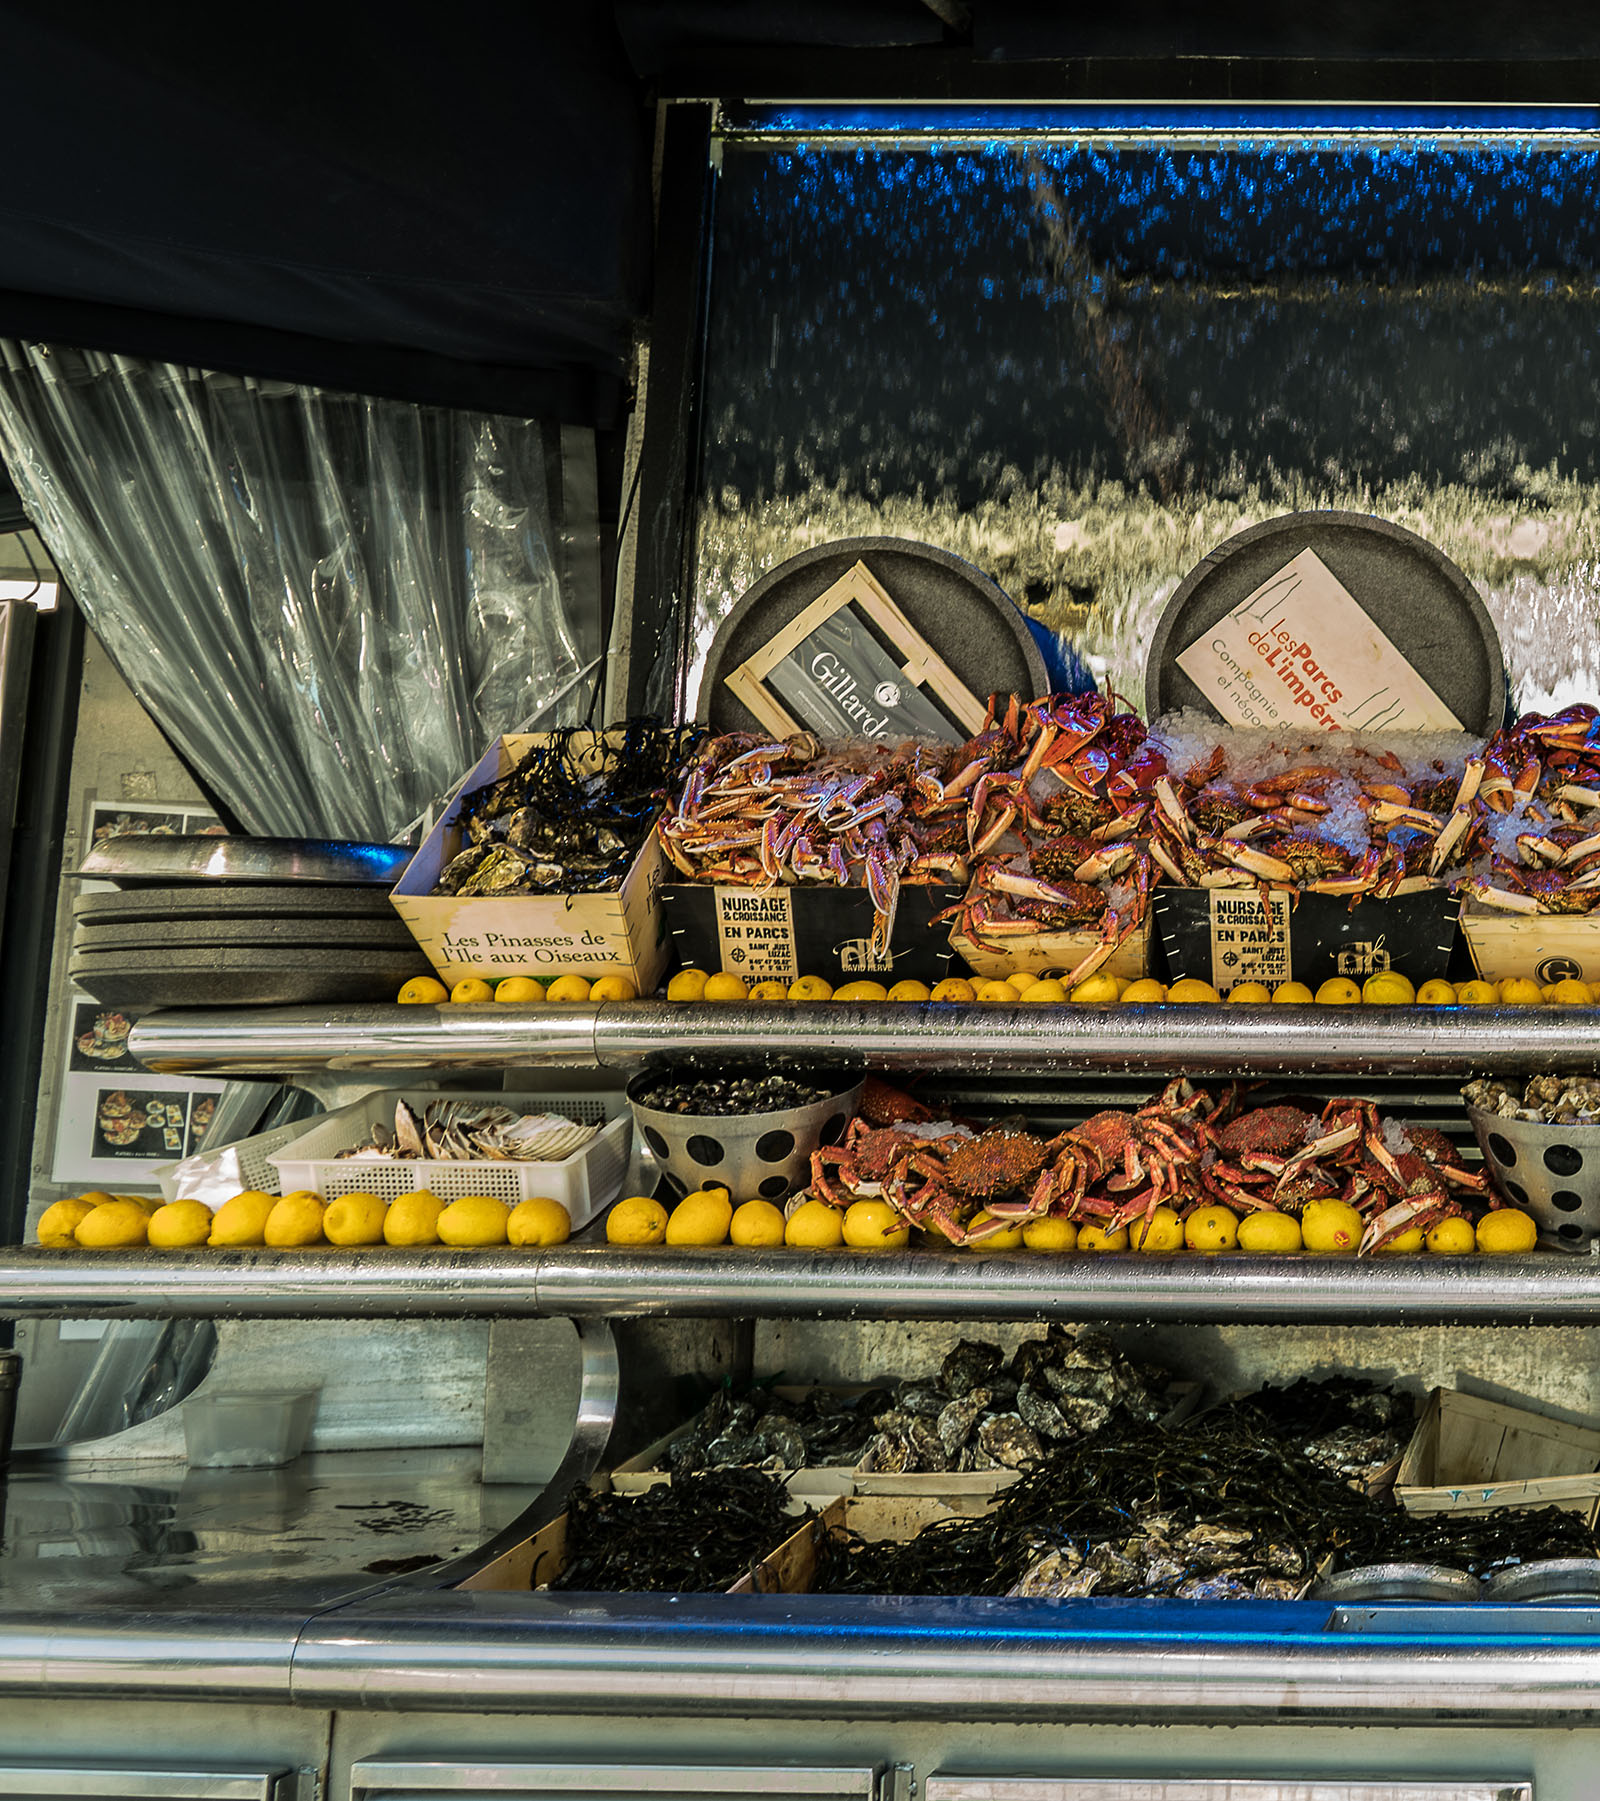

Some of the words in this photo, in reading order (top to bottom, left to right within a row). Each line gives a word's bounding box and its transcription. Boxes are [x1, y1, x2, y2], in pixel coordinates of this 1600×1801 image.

[1212, 639, 1280, 720] Compagnie
[1217, 676, 1232, 691] et
[722, 897, 787, 912] NURSAGE
[723, 912, 732, 922] &
[733, 912, 788, 922] CROISSANCE
[1217, 914, 1226, 924] &
[1227, 914, 1286, 925] CROISSACE
[442, 932, 480, 947] Les
[484, 933, 574, 947] Pinasses
[580, 930, 606, 946] de
[724, 927, 742, 938] EN
[746, 927, 790, 939] PARCS
[1217, 930, 1235, 942] EN
[490, 951, 528, 963] aux
[534, 949, 621, 963] Oiseaux
[768, 950, 791, 958] LUZAC
